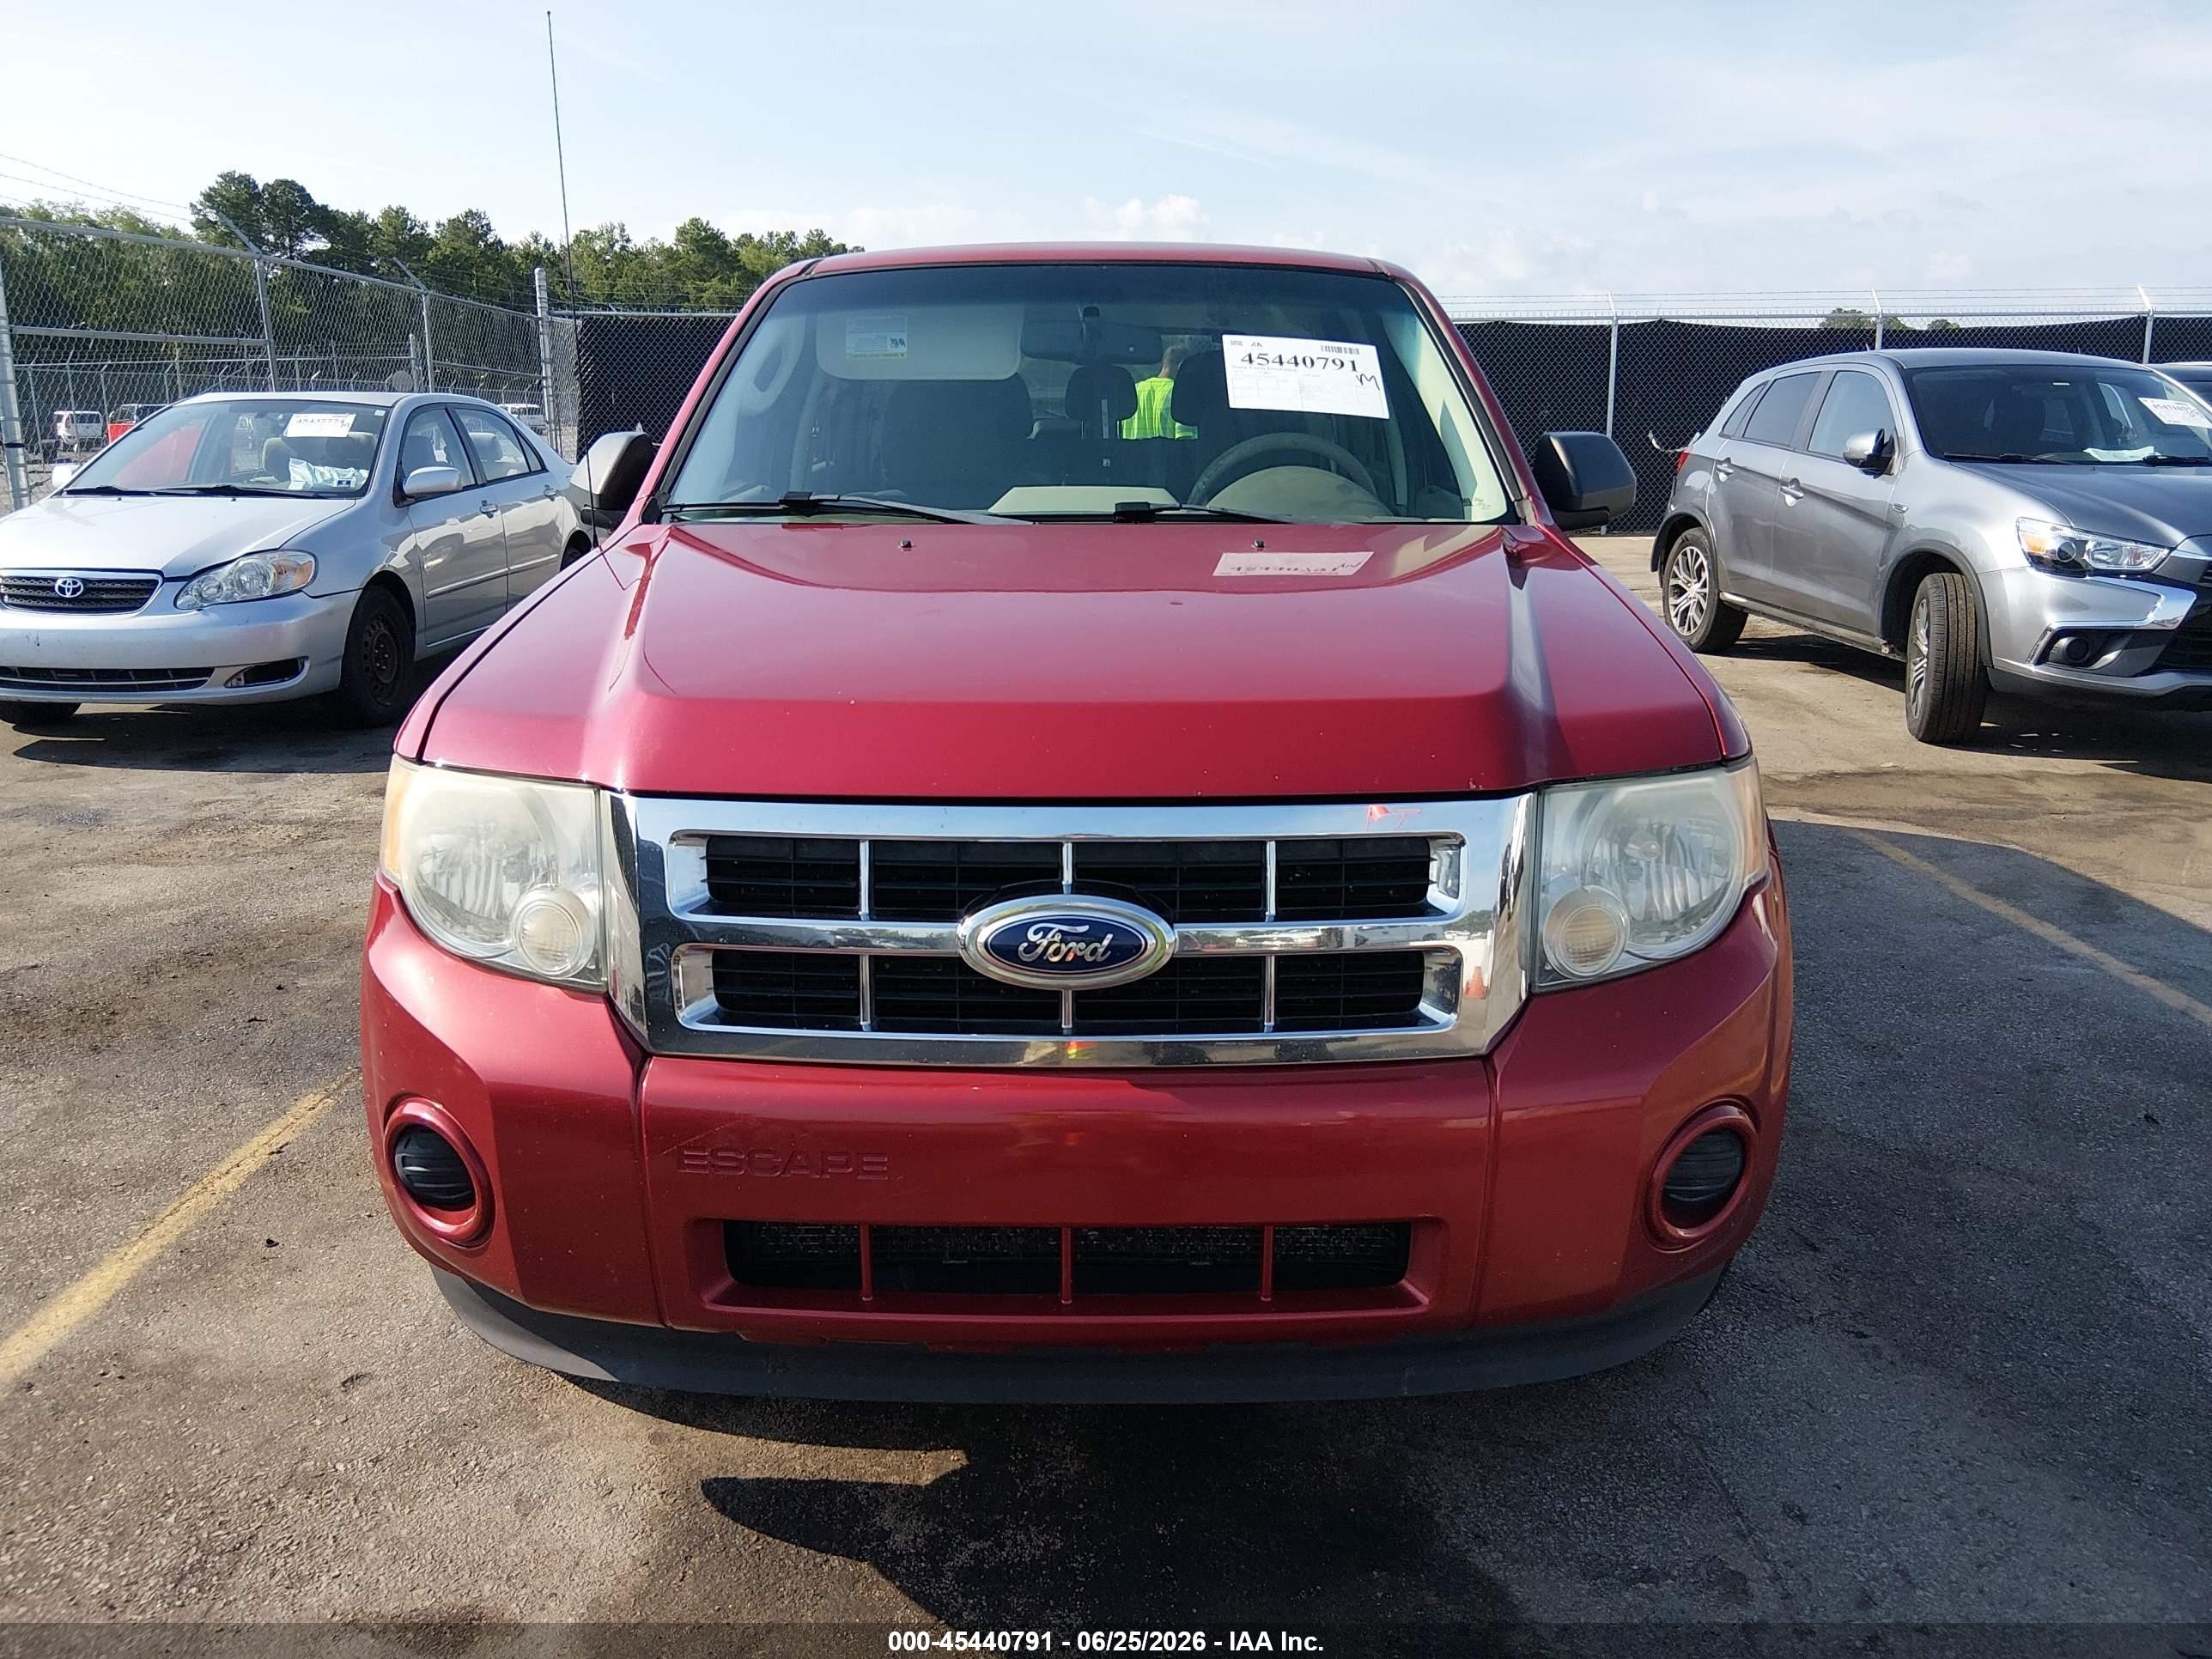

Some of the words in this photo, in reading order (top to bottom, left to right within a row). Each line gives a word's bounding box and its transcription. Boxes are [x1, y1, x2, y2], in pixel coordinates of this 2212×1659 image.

[1240, 352, 1359, 372] 45440791
[1018, 922, 1114, 963] Ford
[678, 1147, 889, 1180] ESCAPE
